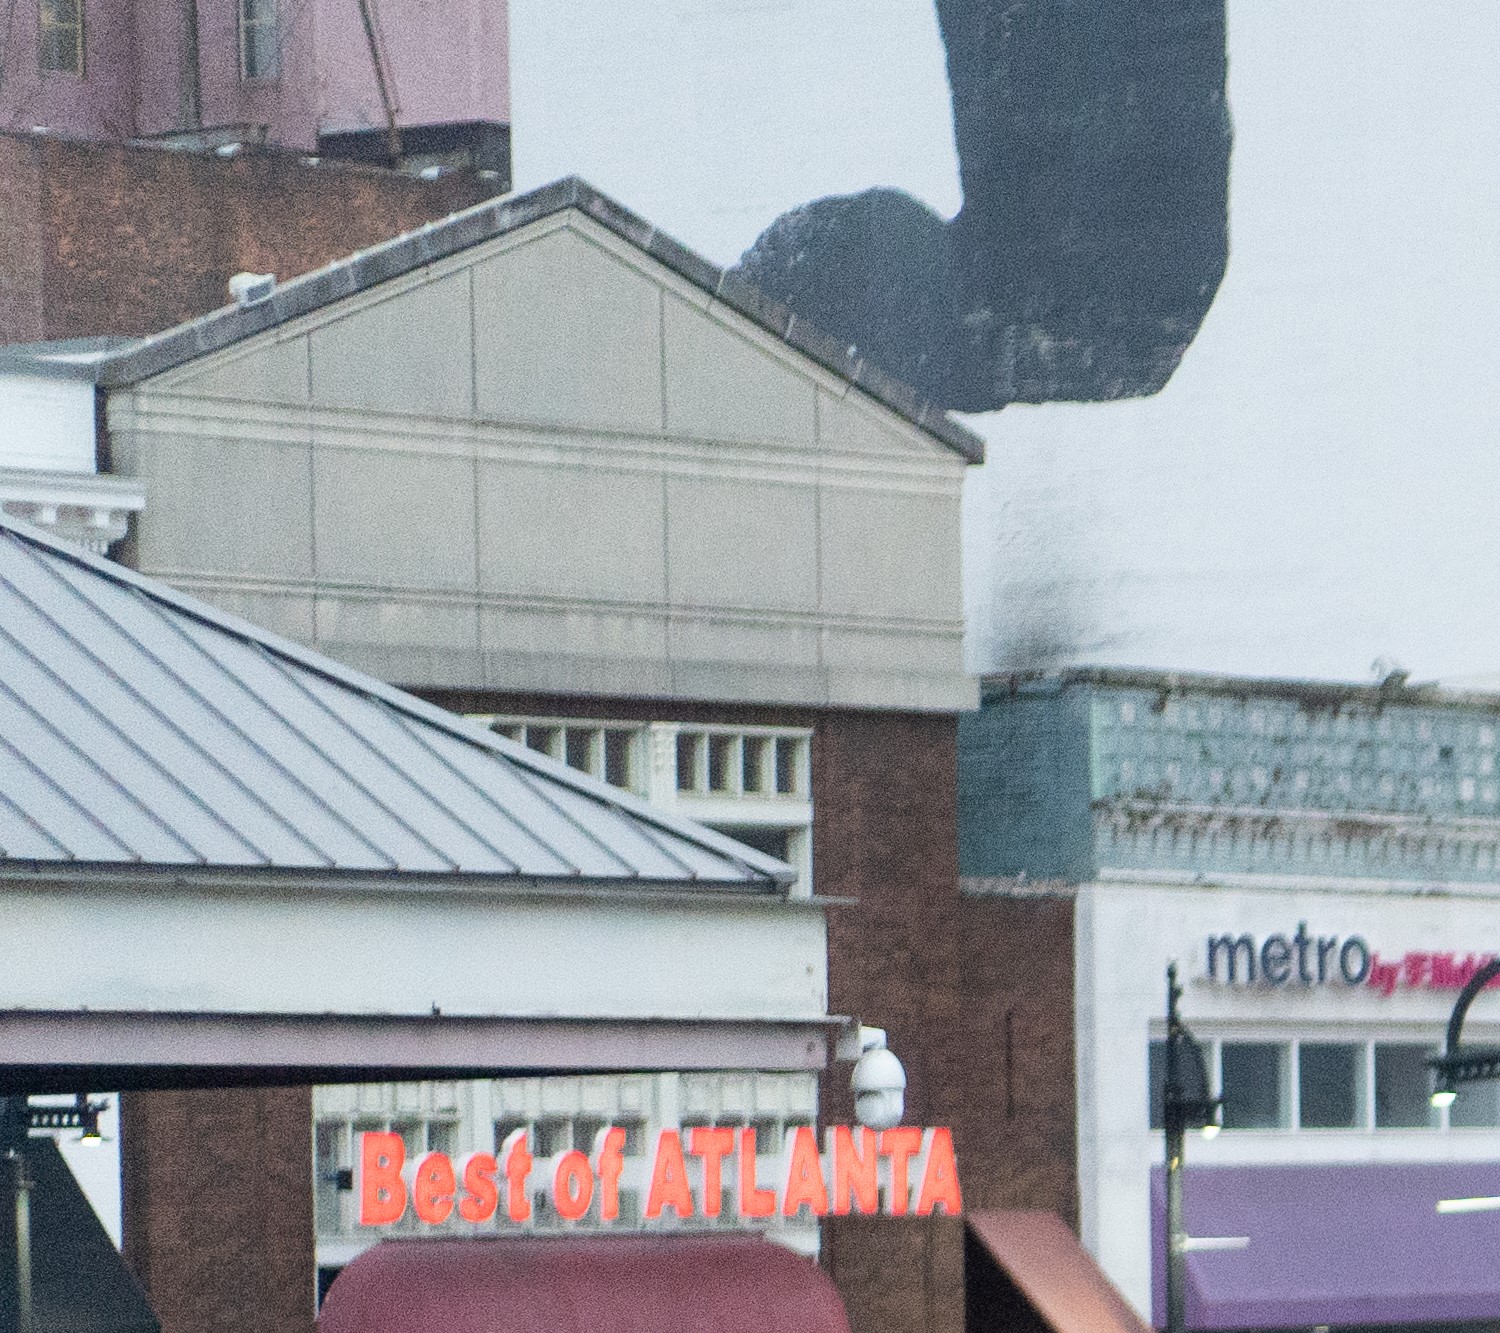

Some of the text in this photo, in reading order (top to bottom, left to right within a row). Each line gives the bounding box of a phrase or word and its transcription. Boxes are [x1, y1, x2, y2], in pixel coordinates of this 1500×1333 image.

[1207, 919, 1369, 986] metro
[358, 1126, 962, 1226] Best of ATLANTA
